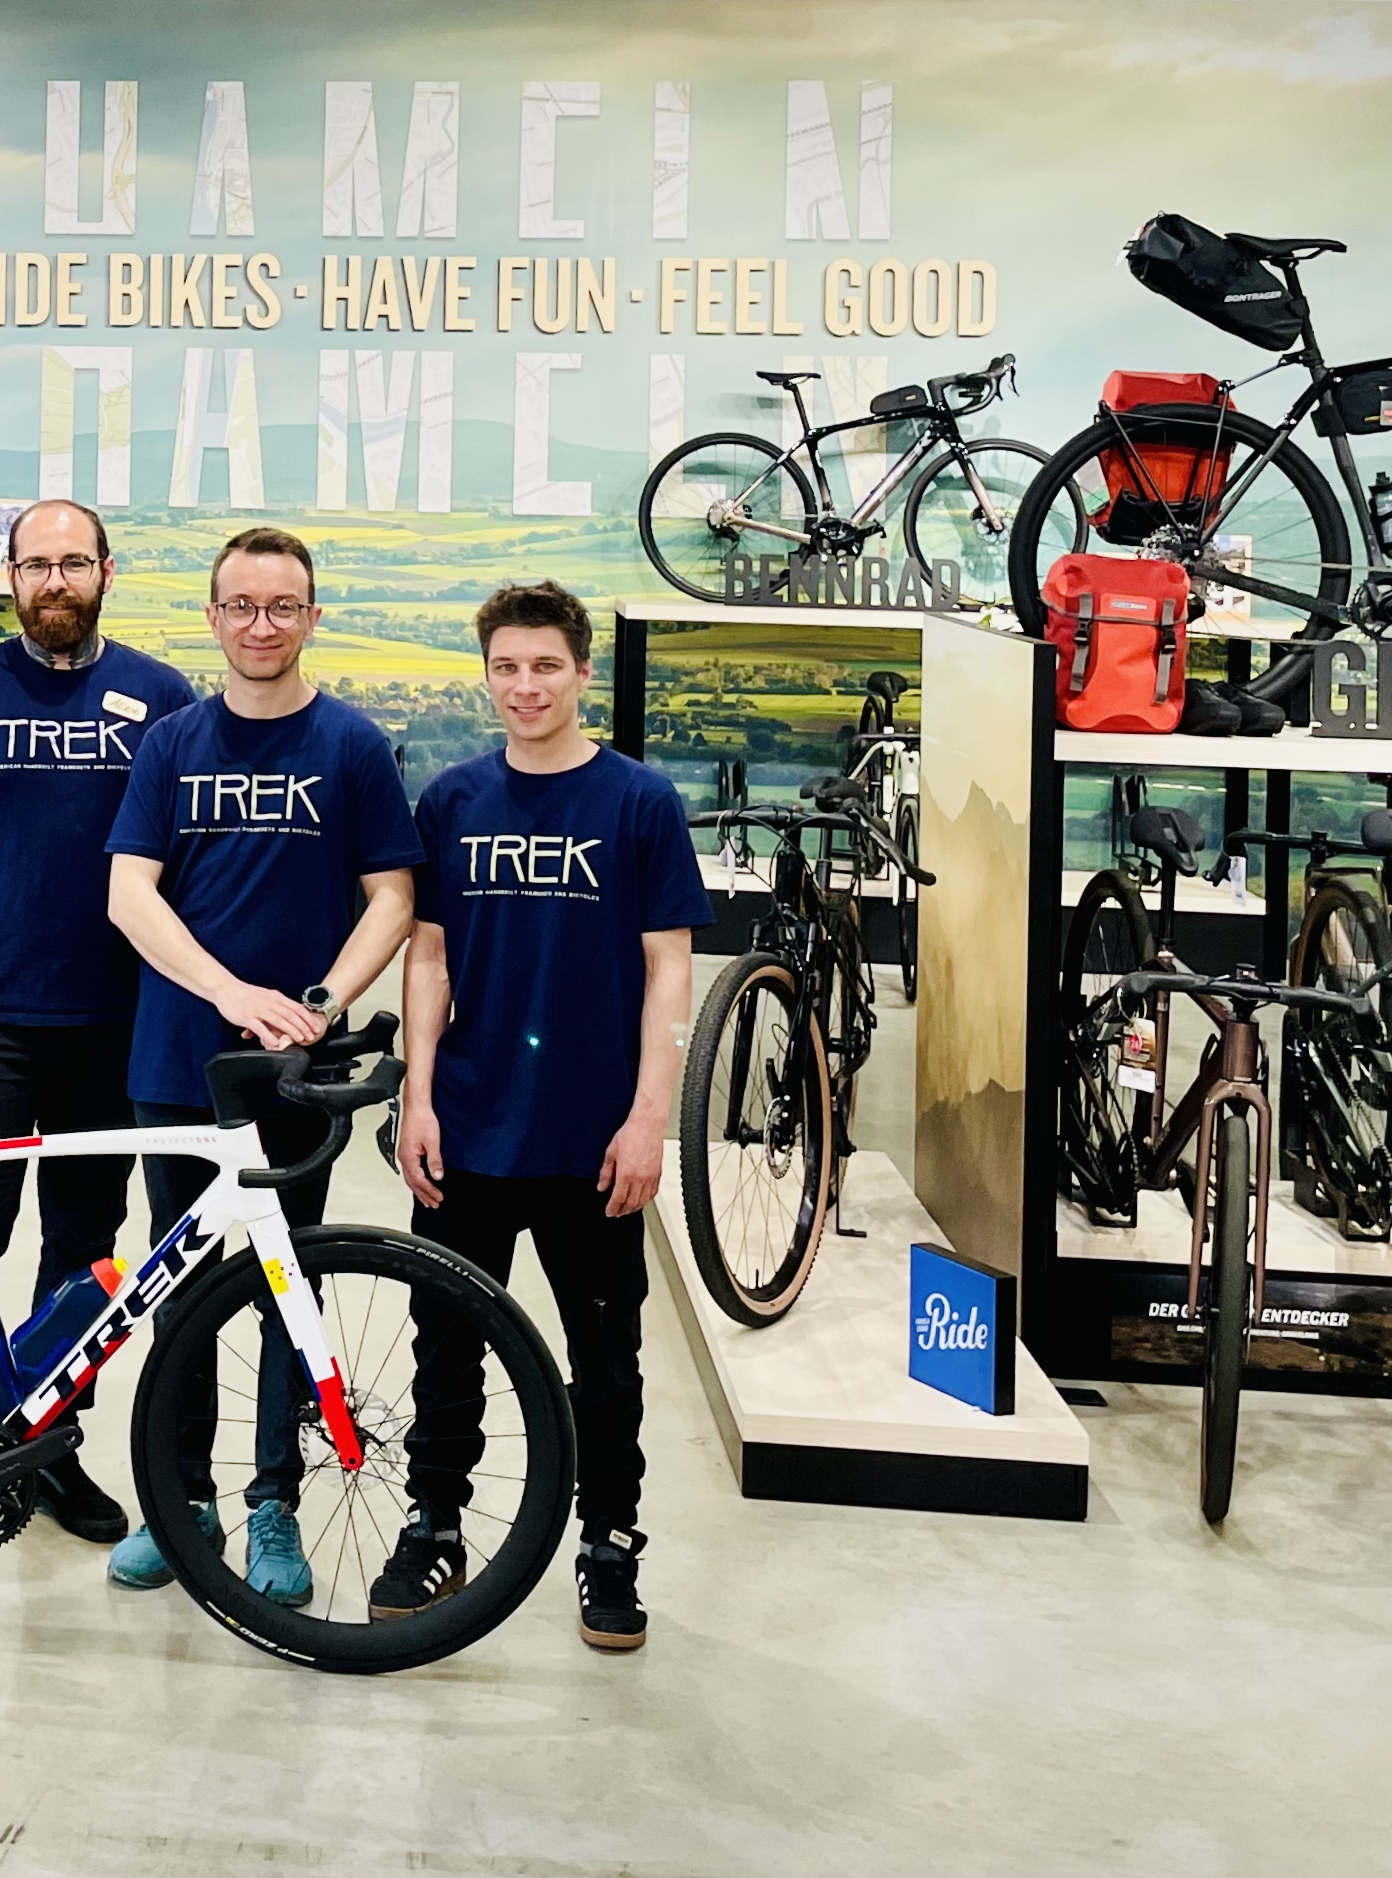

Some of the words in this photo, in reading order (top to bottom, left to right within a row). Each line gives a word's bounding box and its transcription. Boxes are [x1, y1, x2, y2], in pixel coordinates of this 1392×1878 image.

[108, 252, 282, 330] BIKES
[321, 255, 476, 332] HAVE
[497, 256, 616, 334] FUN
[659, 257, 804, 335] FEEL
[824, 257, 997, 337] GOOD
[1223, 290, 1283, 303] BONTRAGER
[179, 774, 323, 823] TREK
[460, 835, 603, 888] TREK
[415, 1247, 469, 1276] PIRELLI
[38, 1213, 216, 1402] TREK
[918, 1292, 988, 1351] Ride
[1148, 1302, 1178, 1318] DER
[1261, 1308, 1350, 1327] ENTDECKER
